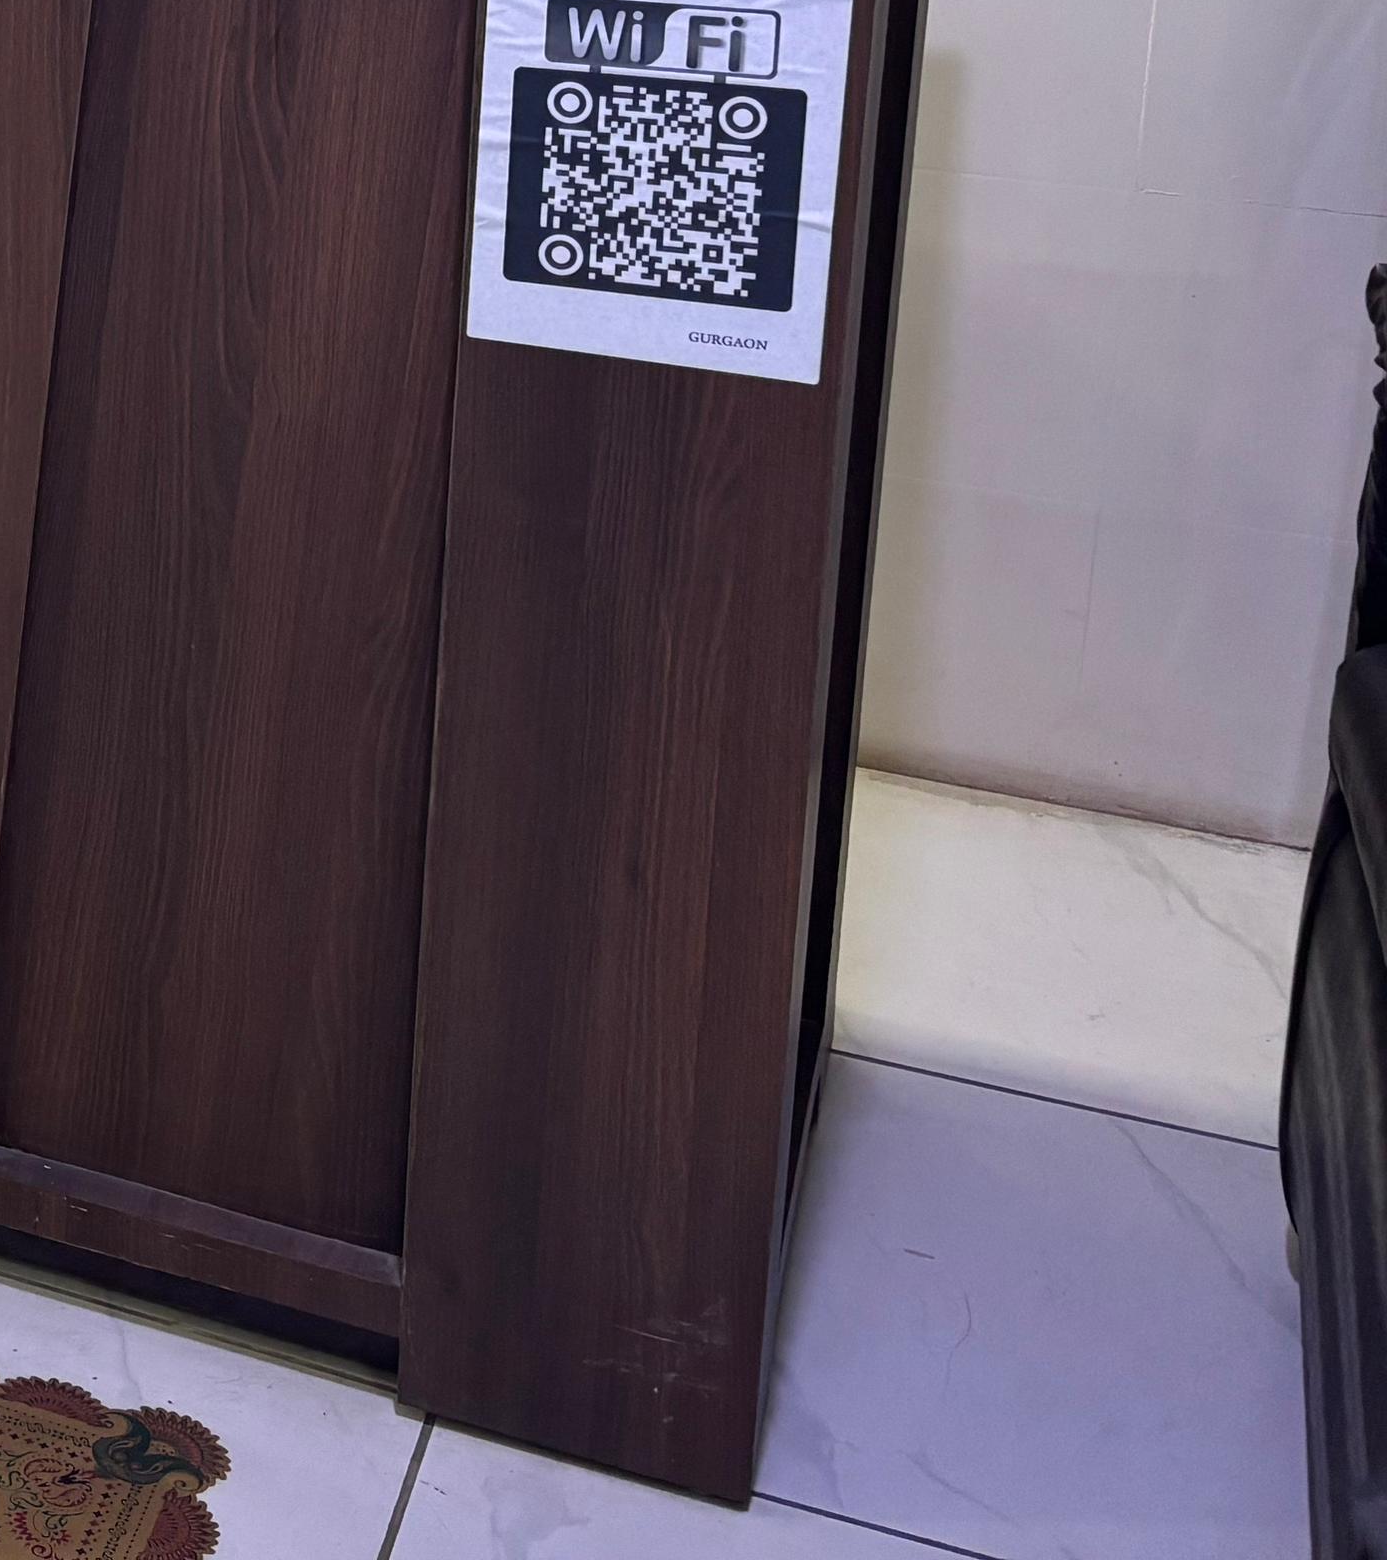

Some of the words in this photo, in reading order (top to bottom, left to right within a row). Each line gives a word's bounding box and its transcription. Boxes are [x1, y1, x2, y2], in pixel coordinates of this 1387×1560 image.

[567, 6, 645, 63] Wi
[686, 15, 744, 72] Fi
[688, 331, 768, 351] GURGAON
